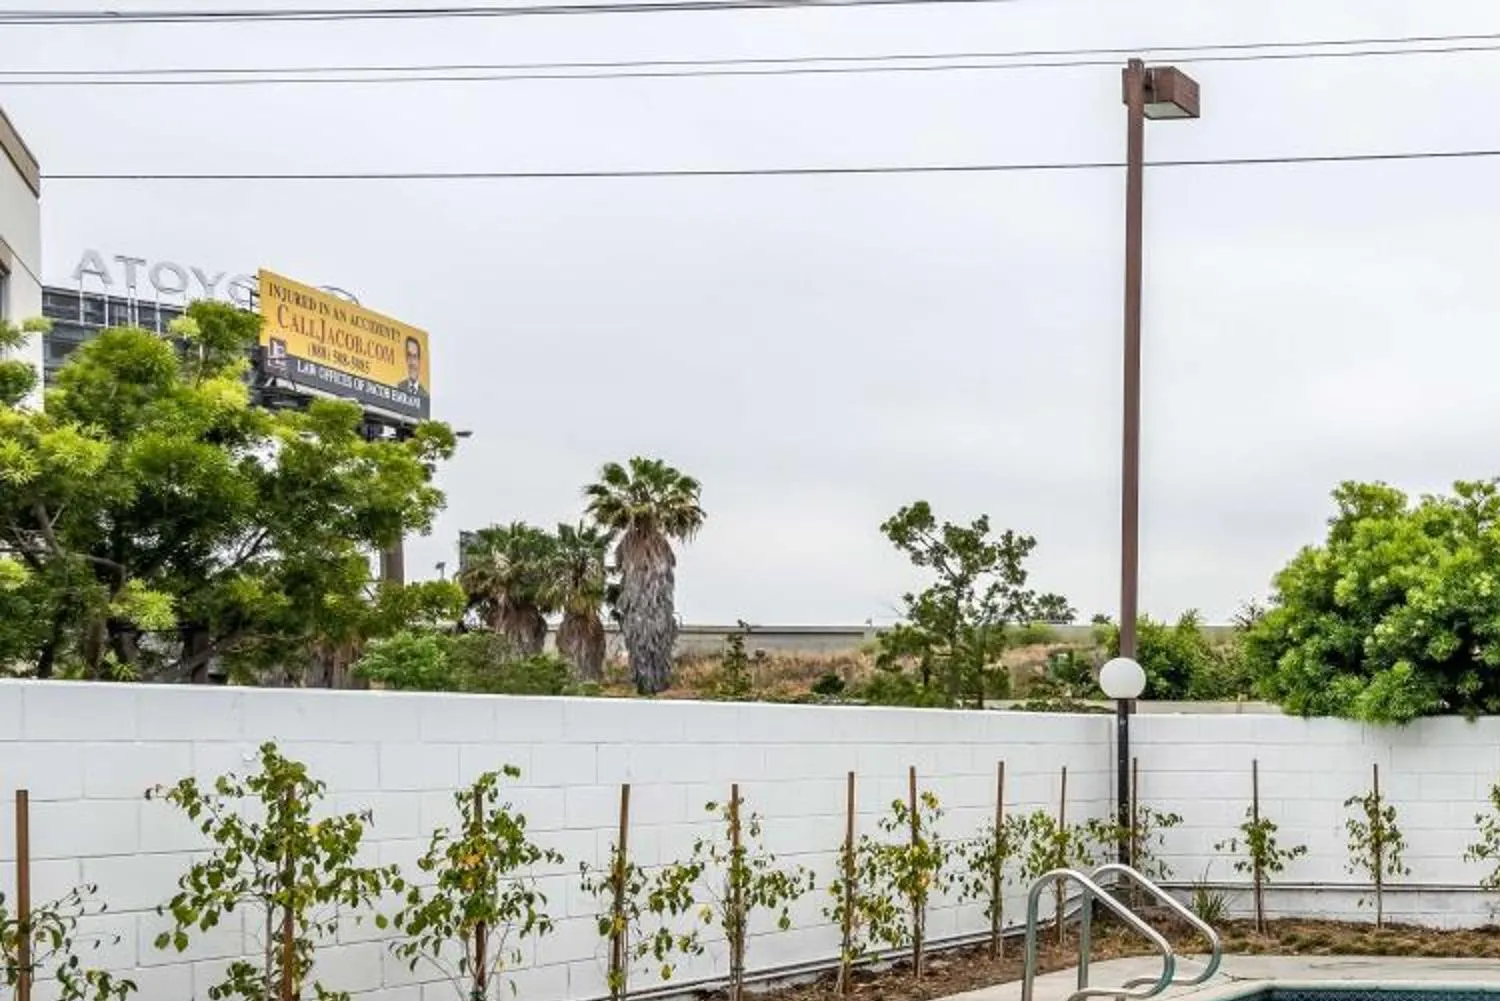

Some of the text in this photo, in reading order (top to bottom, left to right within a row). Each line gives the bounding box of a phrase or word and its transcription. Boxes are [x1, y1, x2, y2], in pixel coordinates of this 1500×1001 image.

[269, 282, 317, 312] INJURED
[319, 301, 331, 316] IN
[332, 308, 346, 322] AN
